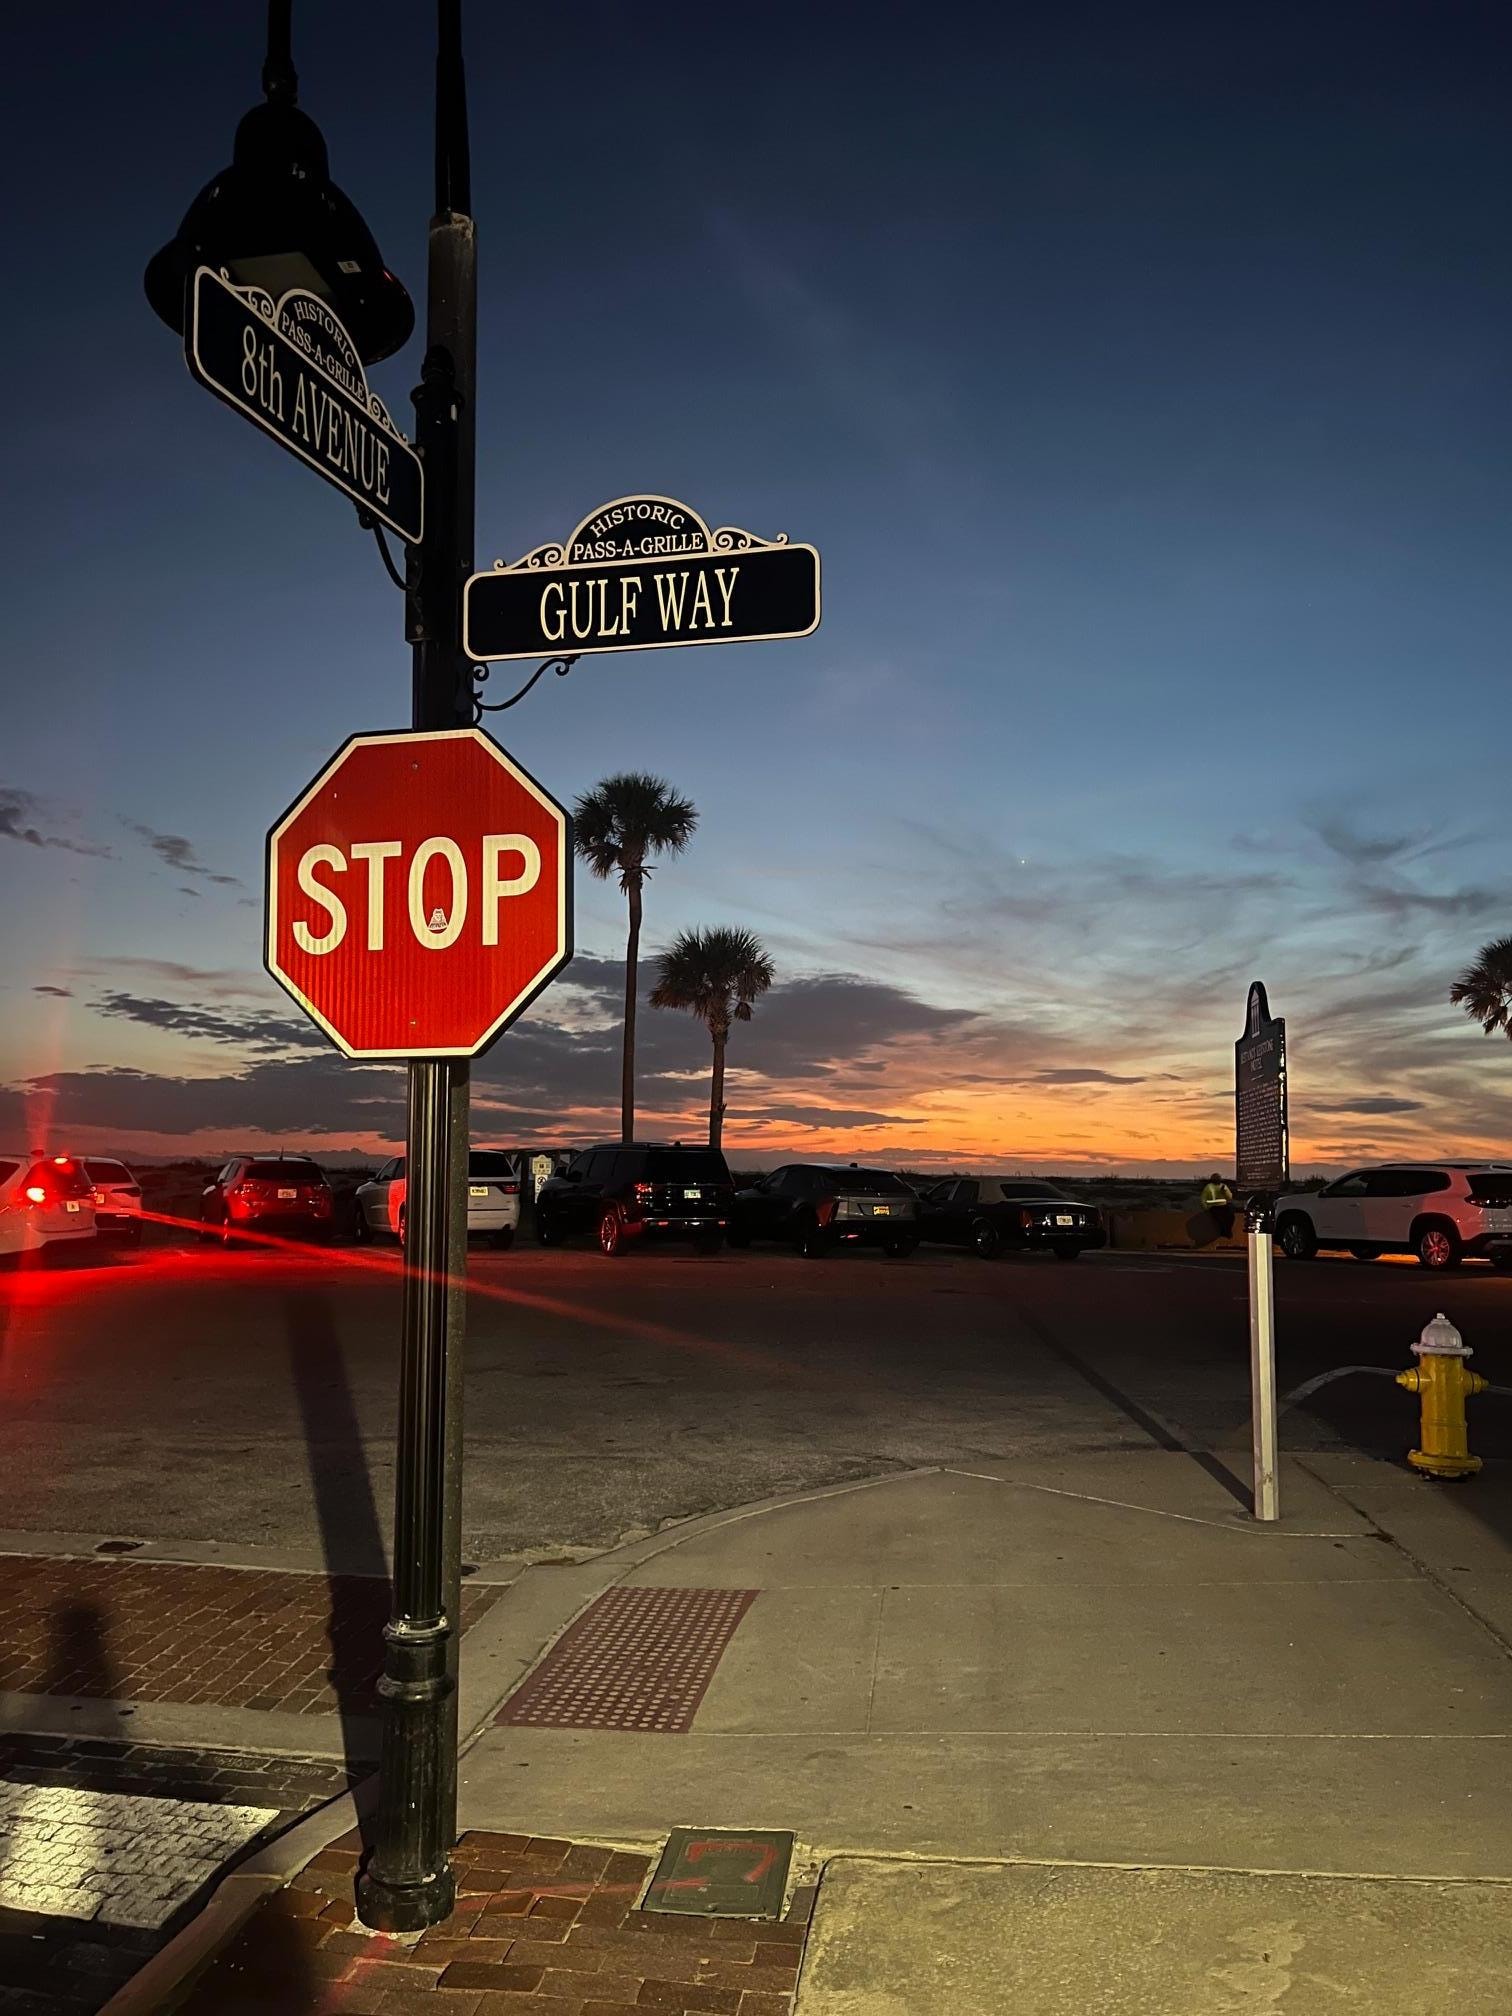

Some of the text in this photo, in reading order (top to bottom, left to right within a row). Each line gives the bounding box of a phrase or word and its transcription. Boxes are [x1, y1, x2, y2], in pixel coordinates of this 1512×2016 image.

[281, 311, 365, 402] PASS-A-GRILLE
[294, 302, 355, 367] HISTORIC
[242, 325, 390, 505] 8th AVENUE
[573, 532, 704, 561] PASS-A-GRILLE
[590, 504, 685, 538] HISTORIC
[540, 567, 740, 641] GULF WAY
[292, 833, 541, 955] STOP
